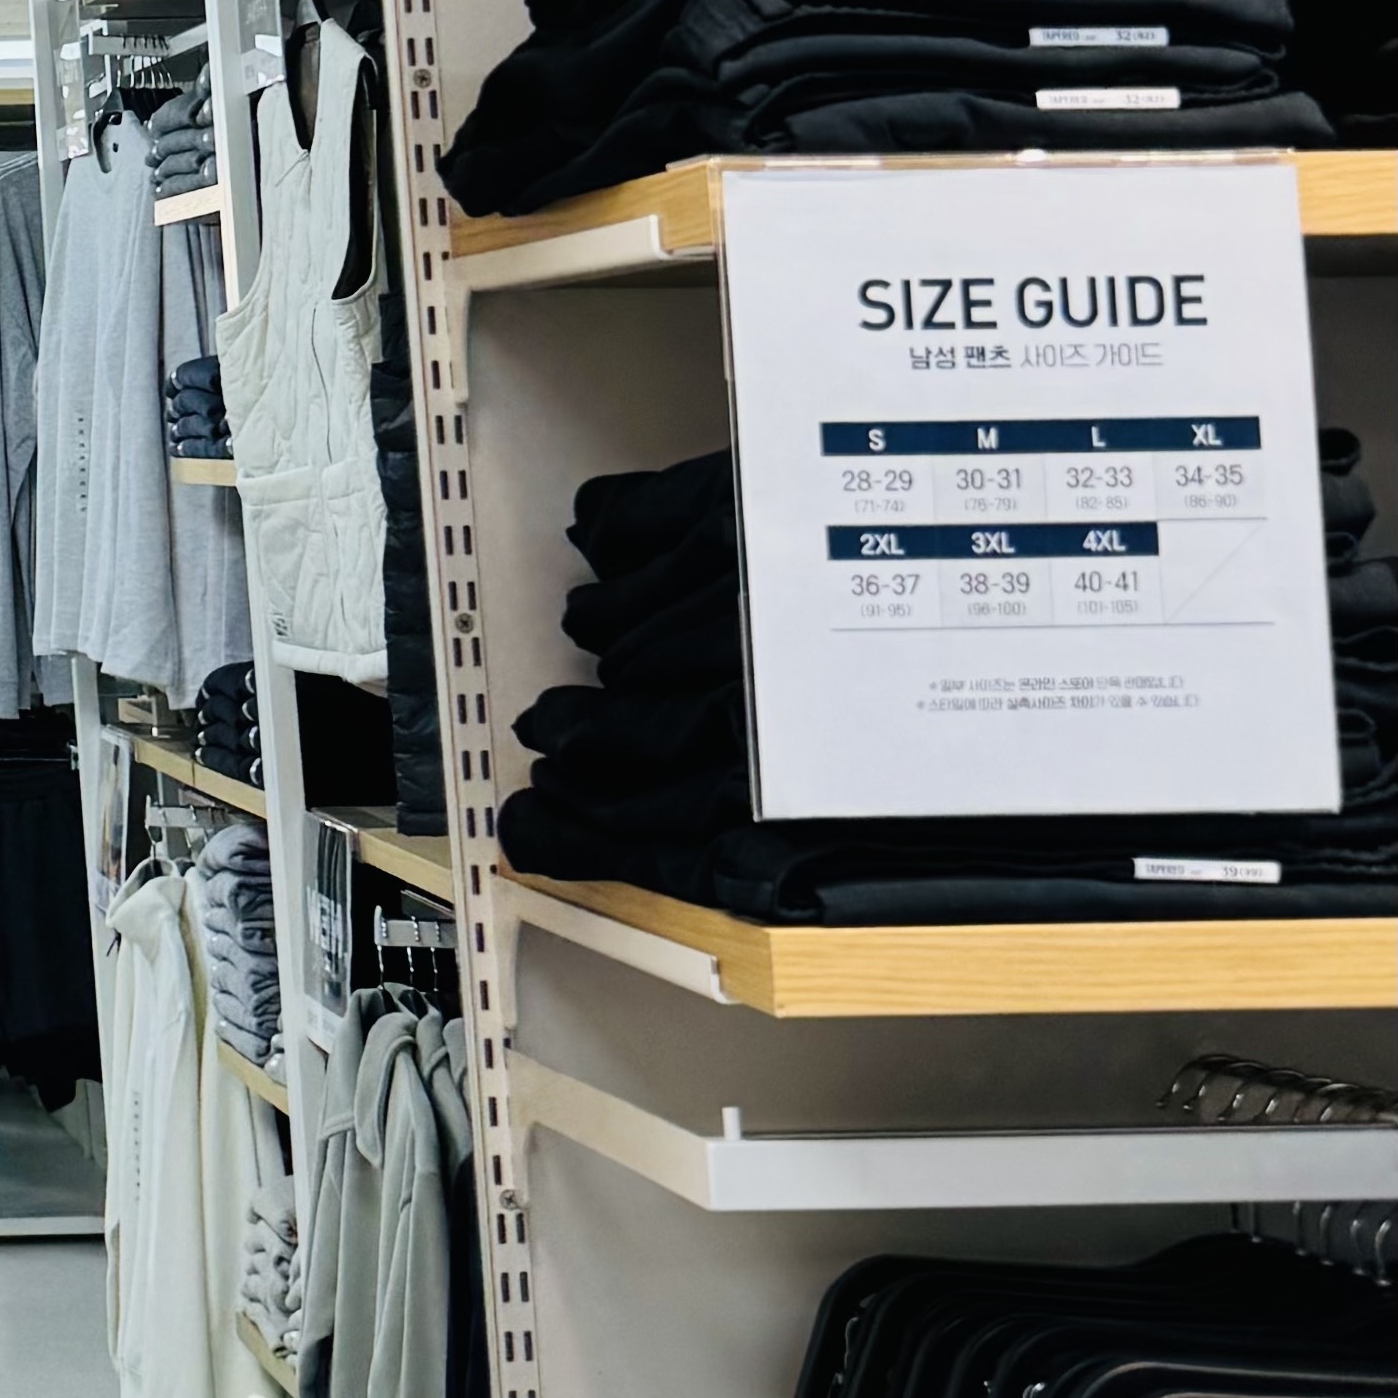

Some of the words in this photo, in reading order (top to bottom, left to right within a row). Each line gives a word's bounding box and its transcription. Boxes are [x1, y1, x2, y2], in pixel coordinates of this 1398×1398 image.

[857, 276, 999, 331] SIZE
[1015, 274, 1208, 330] GUIDE
[909, 345, 957, 369] 남성
[964, 344, 1012, 369] 팬츠
[1019, 343, 1089, 369] 사이즈
[1094, 342, 1164, 367] 가이드
[868, 429, 886, 451] S
[976, 427, 999, 450] M
[1091, 426, 1106, 448] L
[1191, 424, 1222, 446] XL
[842, 469, 913, 492] 28-29
[955, 468, 1022, 491] 30-31
[1065, 466, 1134, 489] 32-33
[1175, 464, 1244, 487] 34-35
[859, 532, 905, 556] 2XL
[970, 531, 1016, 555] 3XL
[1082, 529, 1127, 553] 4XL
[850, 573, 921, 596] 36-37
[959, 572, 1031, 595] 38-39
[1074, 570, 1140, 593] 40-41
